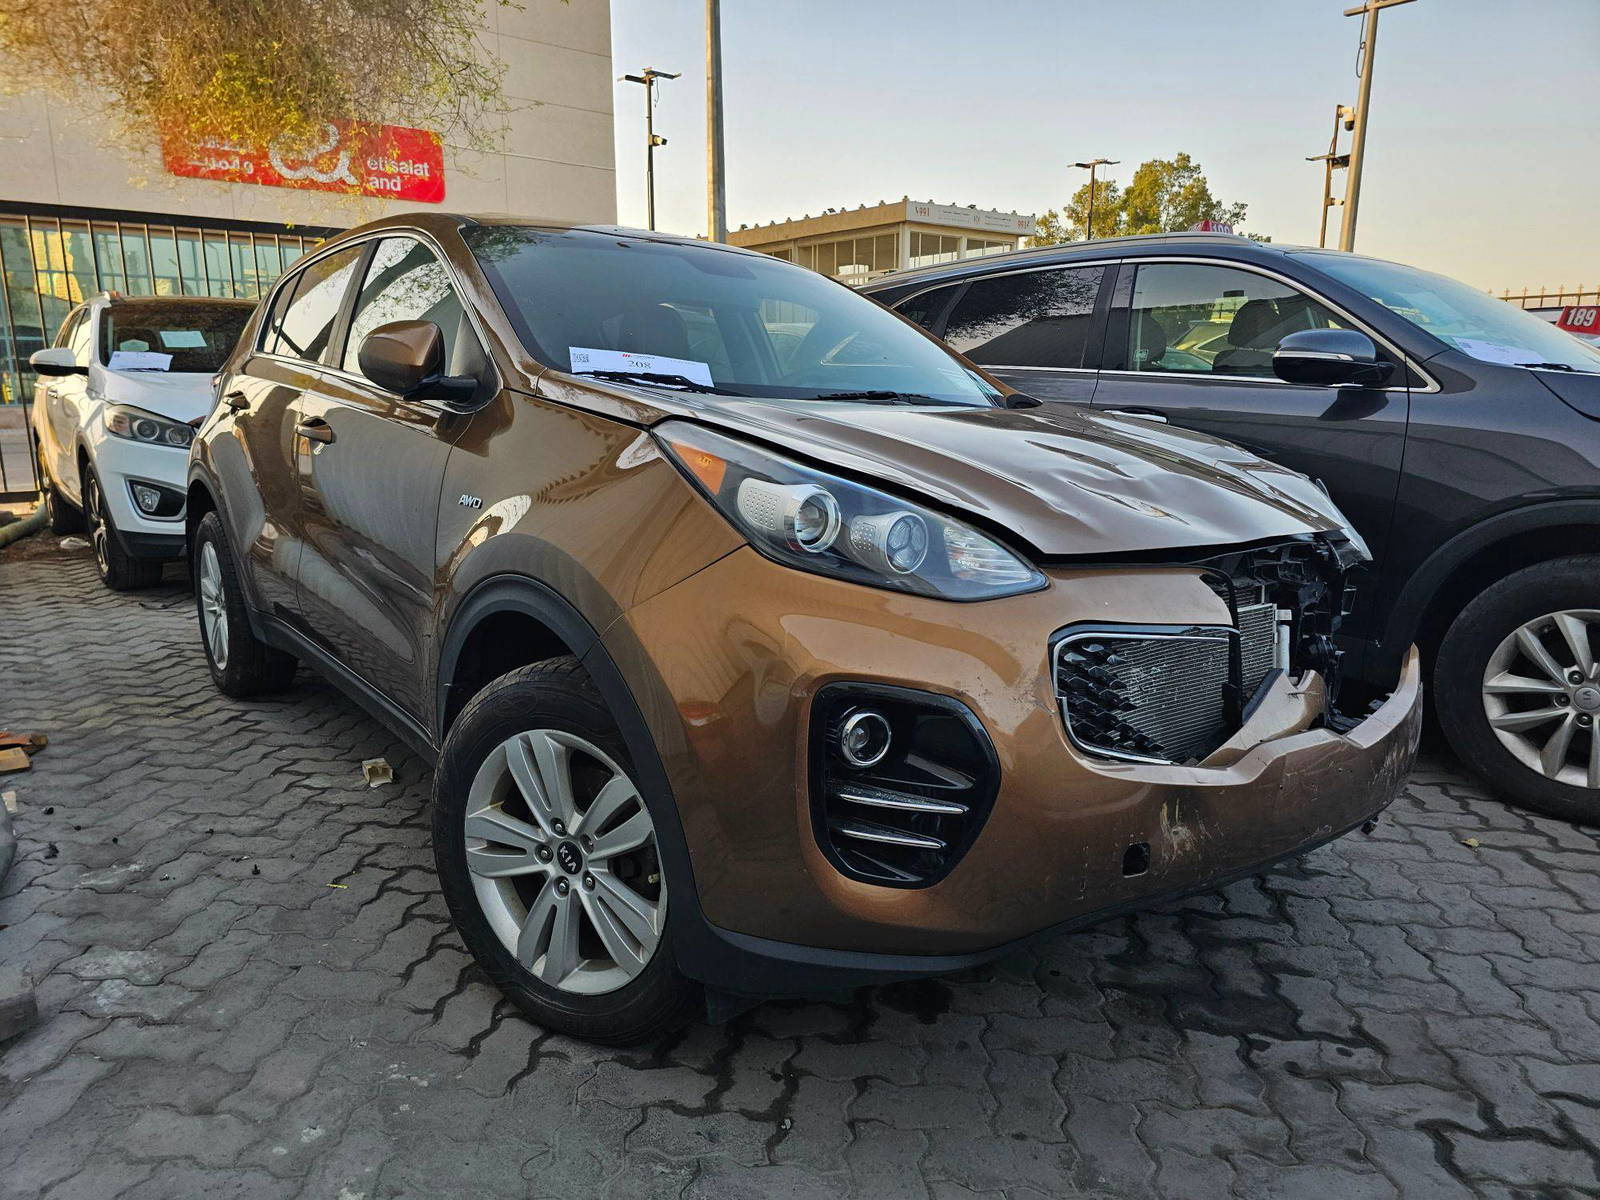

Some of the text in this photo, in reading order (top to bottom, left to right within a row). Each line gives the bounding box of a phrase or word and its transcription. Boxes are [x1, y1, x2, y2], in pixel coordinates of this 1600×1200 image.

[367, 156, 430, 177] etisalat
[369, 175, 401, 191] and
[1566, 307, 1597, 327] 189
[458, 494, 482, 509] AWD
[560, 845, 577, 872] KIA
